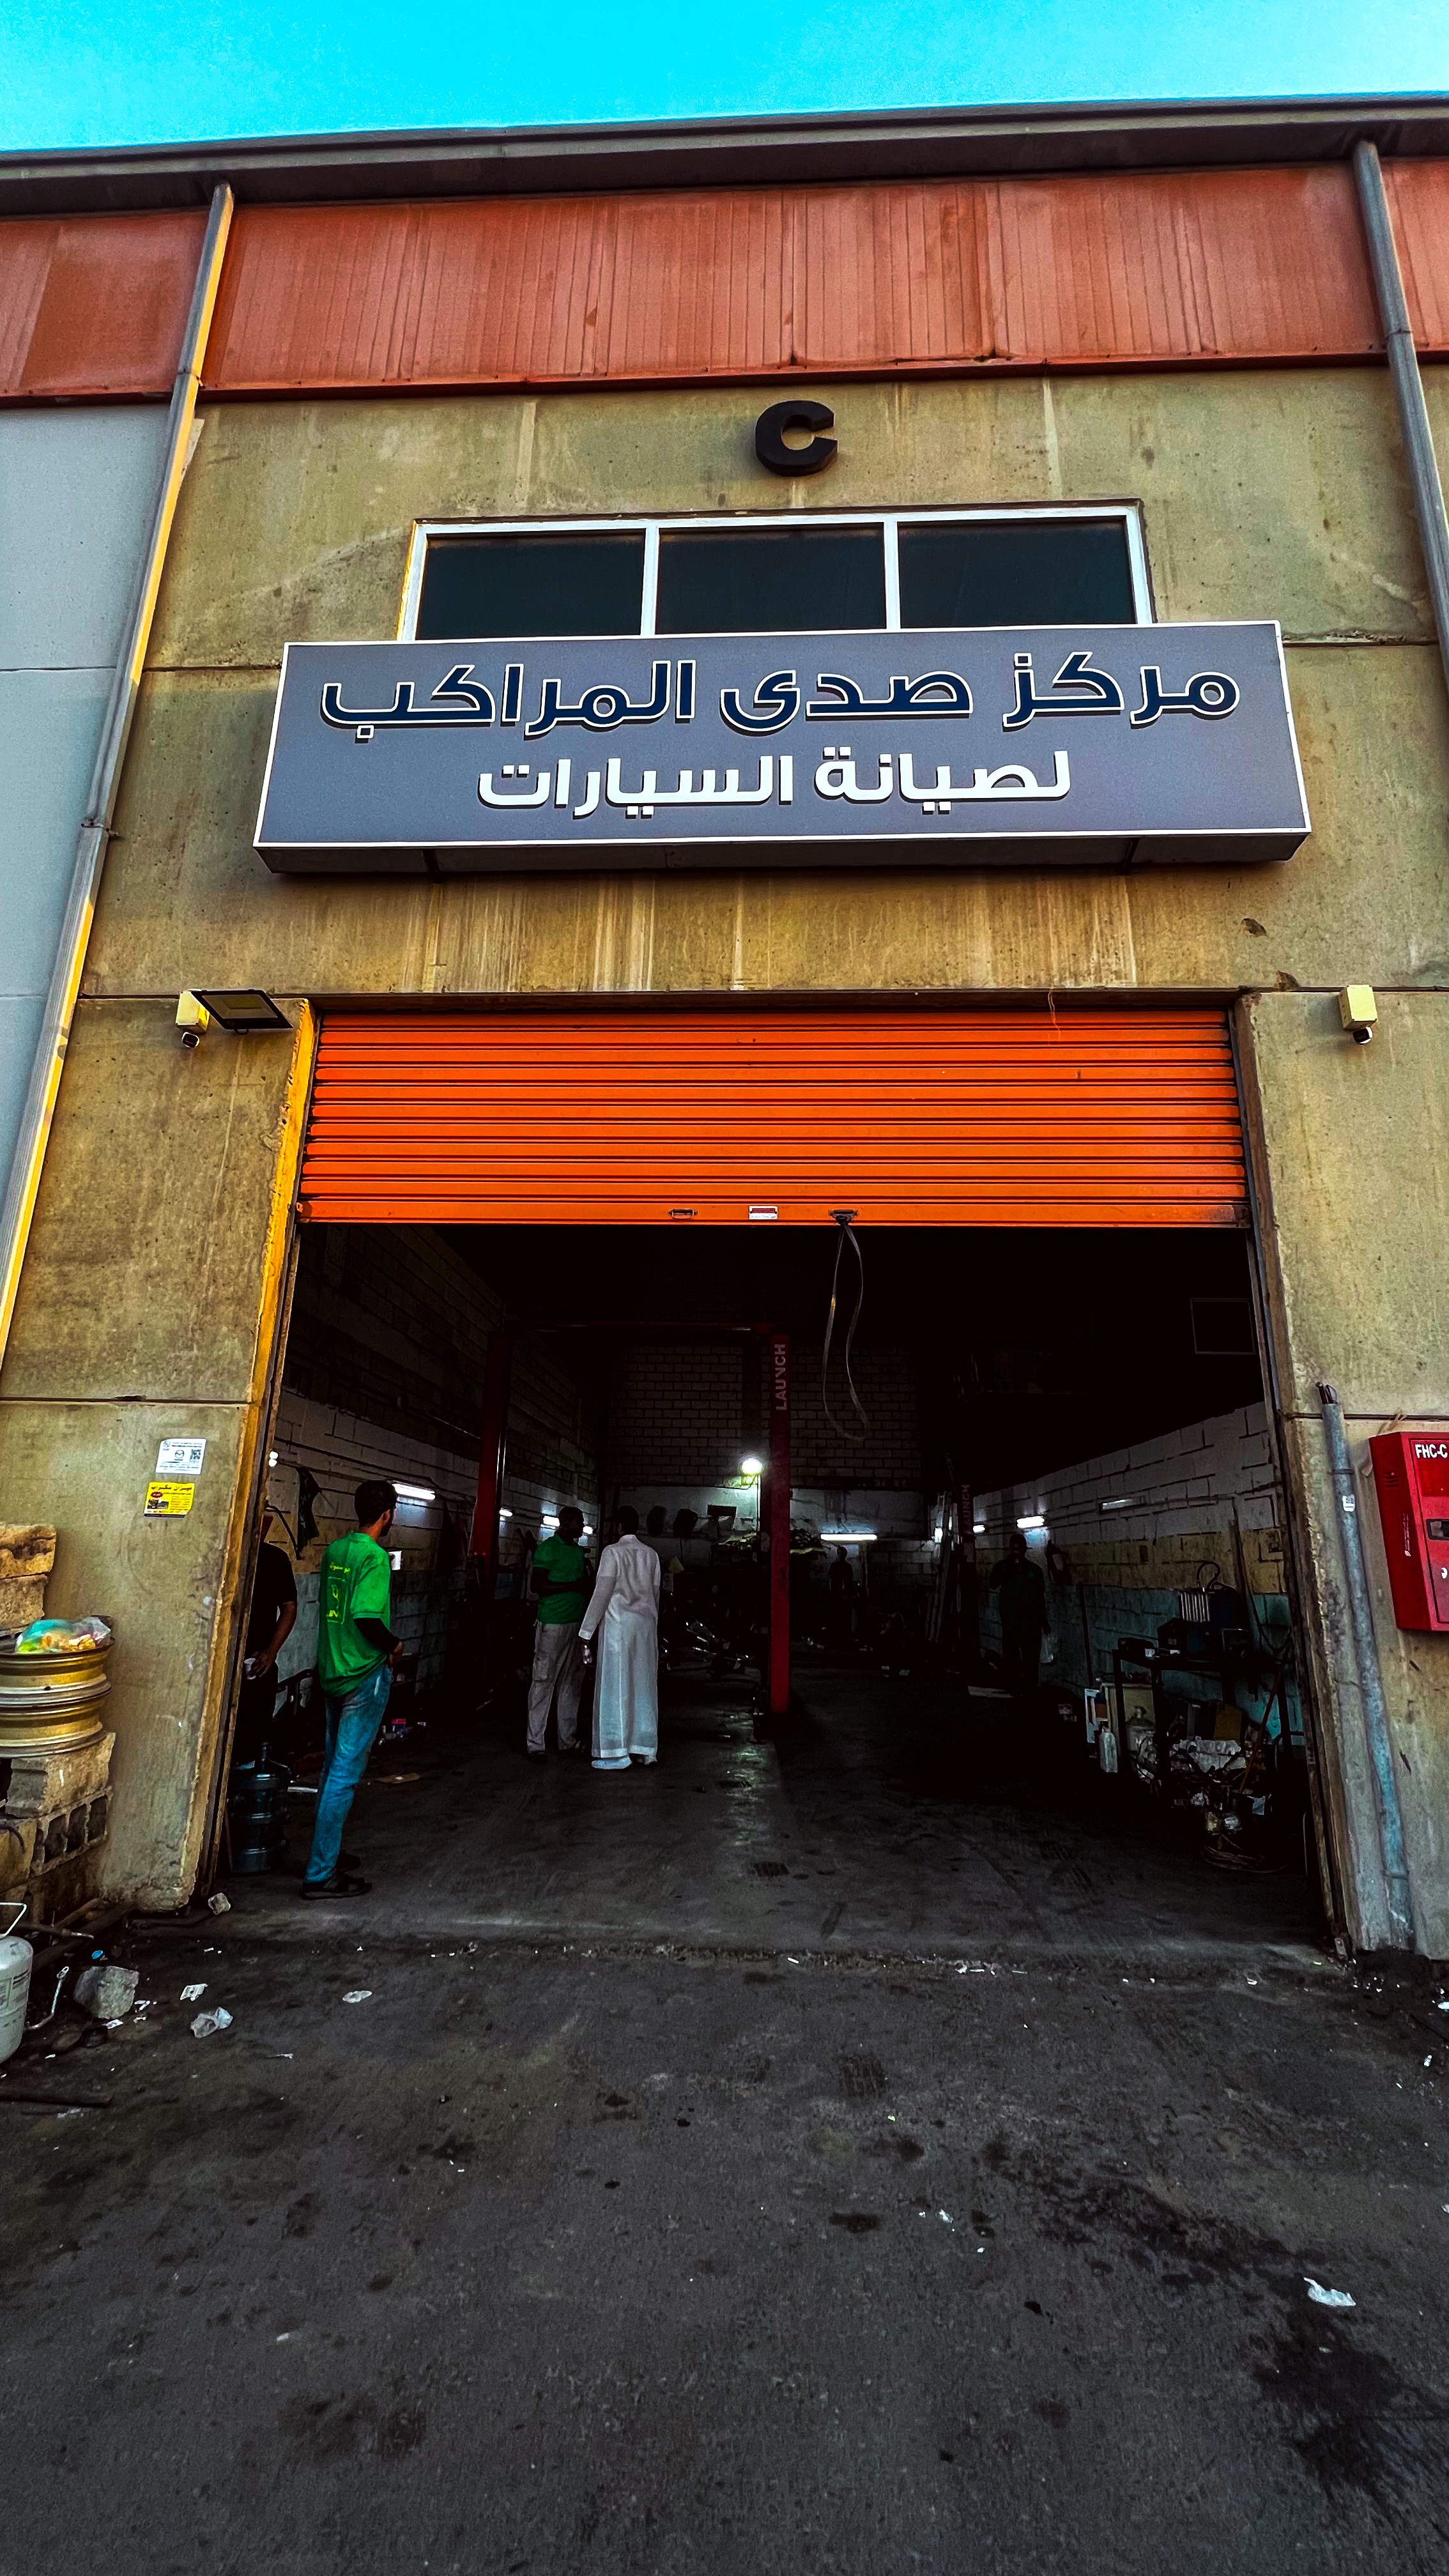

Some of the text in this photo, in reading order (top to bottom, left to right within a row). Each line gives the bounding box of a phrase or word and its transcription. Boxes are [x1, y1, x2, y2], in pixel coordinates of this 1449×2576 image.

[755, 399, 838, 477] C
[321, 651, 1241, 740] مركز صدى المراكب
[478, 746, 1071, 817] لصيانة السيارات
[774, 1344, 786, 1411] LAUNCH
[1414, 1444, 1448, 1459] FHC-C
